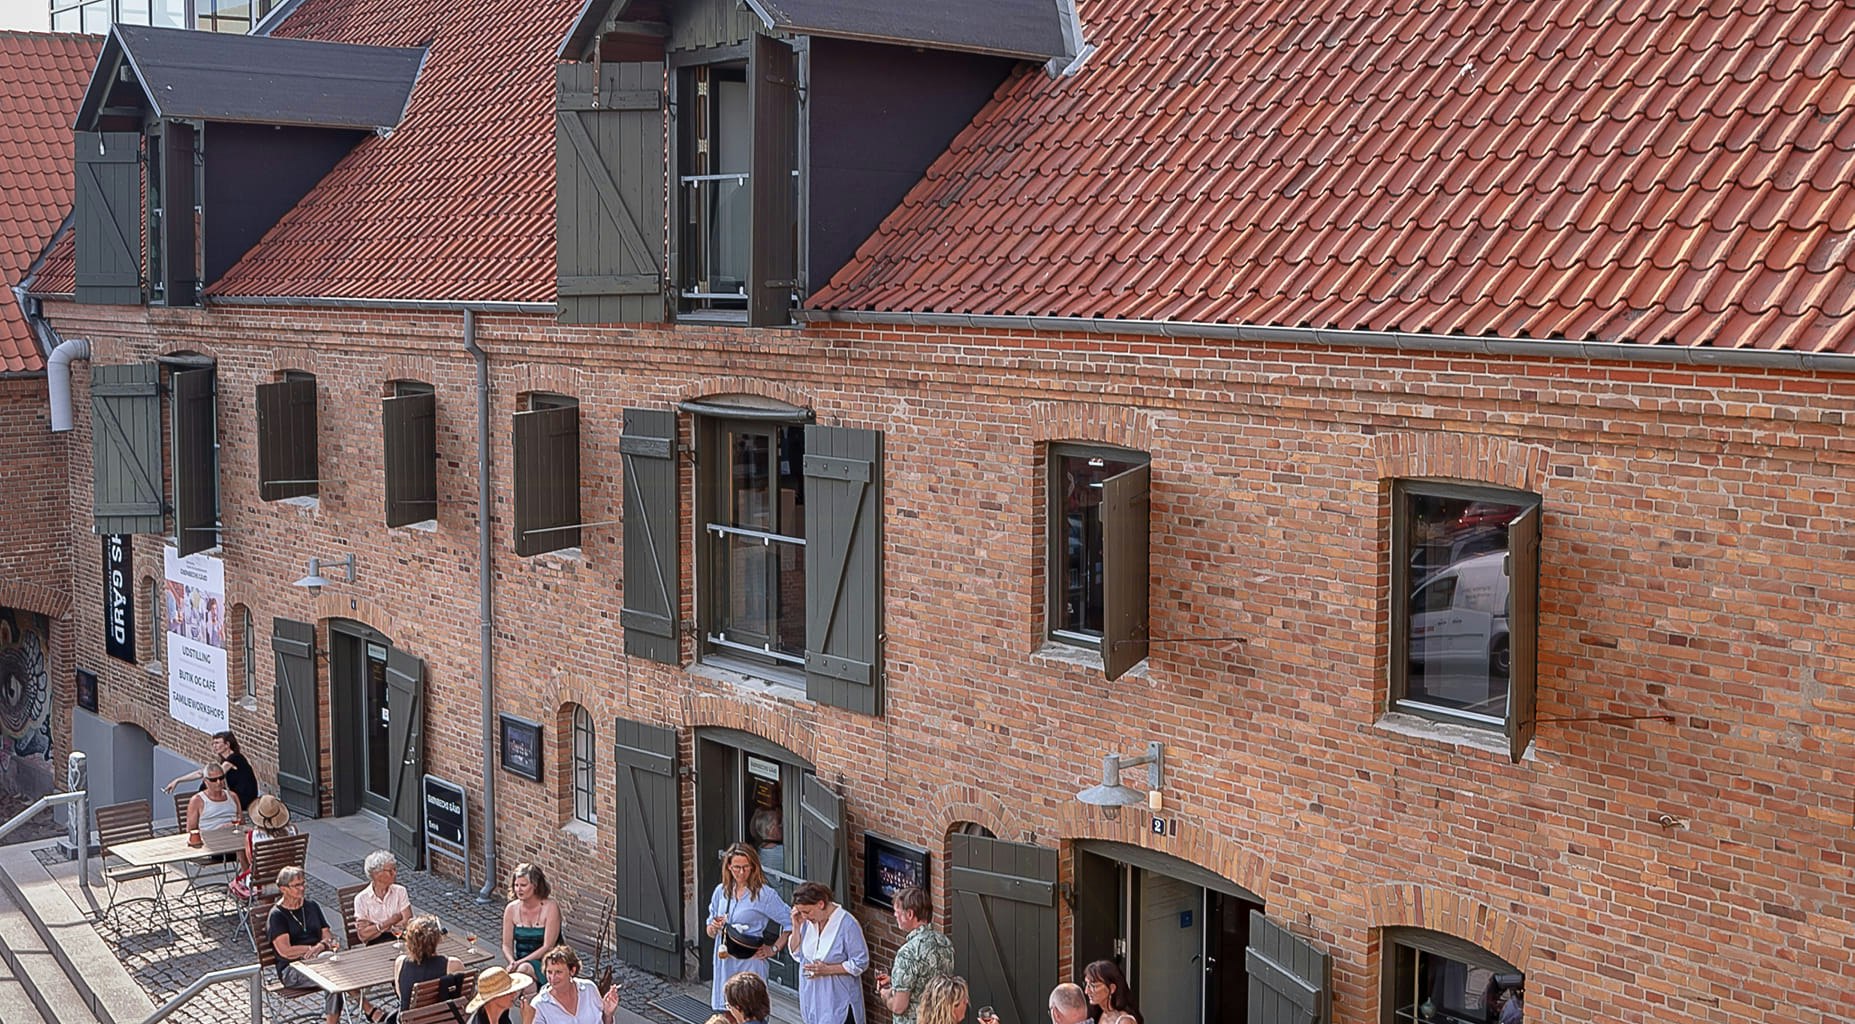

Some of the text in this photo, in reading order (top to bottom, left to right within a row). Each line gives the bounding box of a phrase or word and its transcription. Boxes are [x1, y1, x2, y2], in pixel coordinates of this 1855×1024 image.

[113, 570, 127, 645] GÅRD
[182, 645, 211, 664] UDSTILLING
[179, 668, 194, 684] BUTIK
[194, 675, 202, 687] OG
[202, 678, 216, 692] CAFÉ
[172, 690, 225, 721] FAMILIEWORKSHOPS
[1154, 820, 1161, 832] 2
